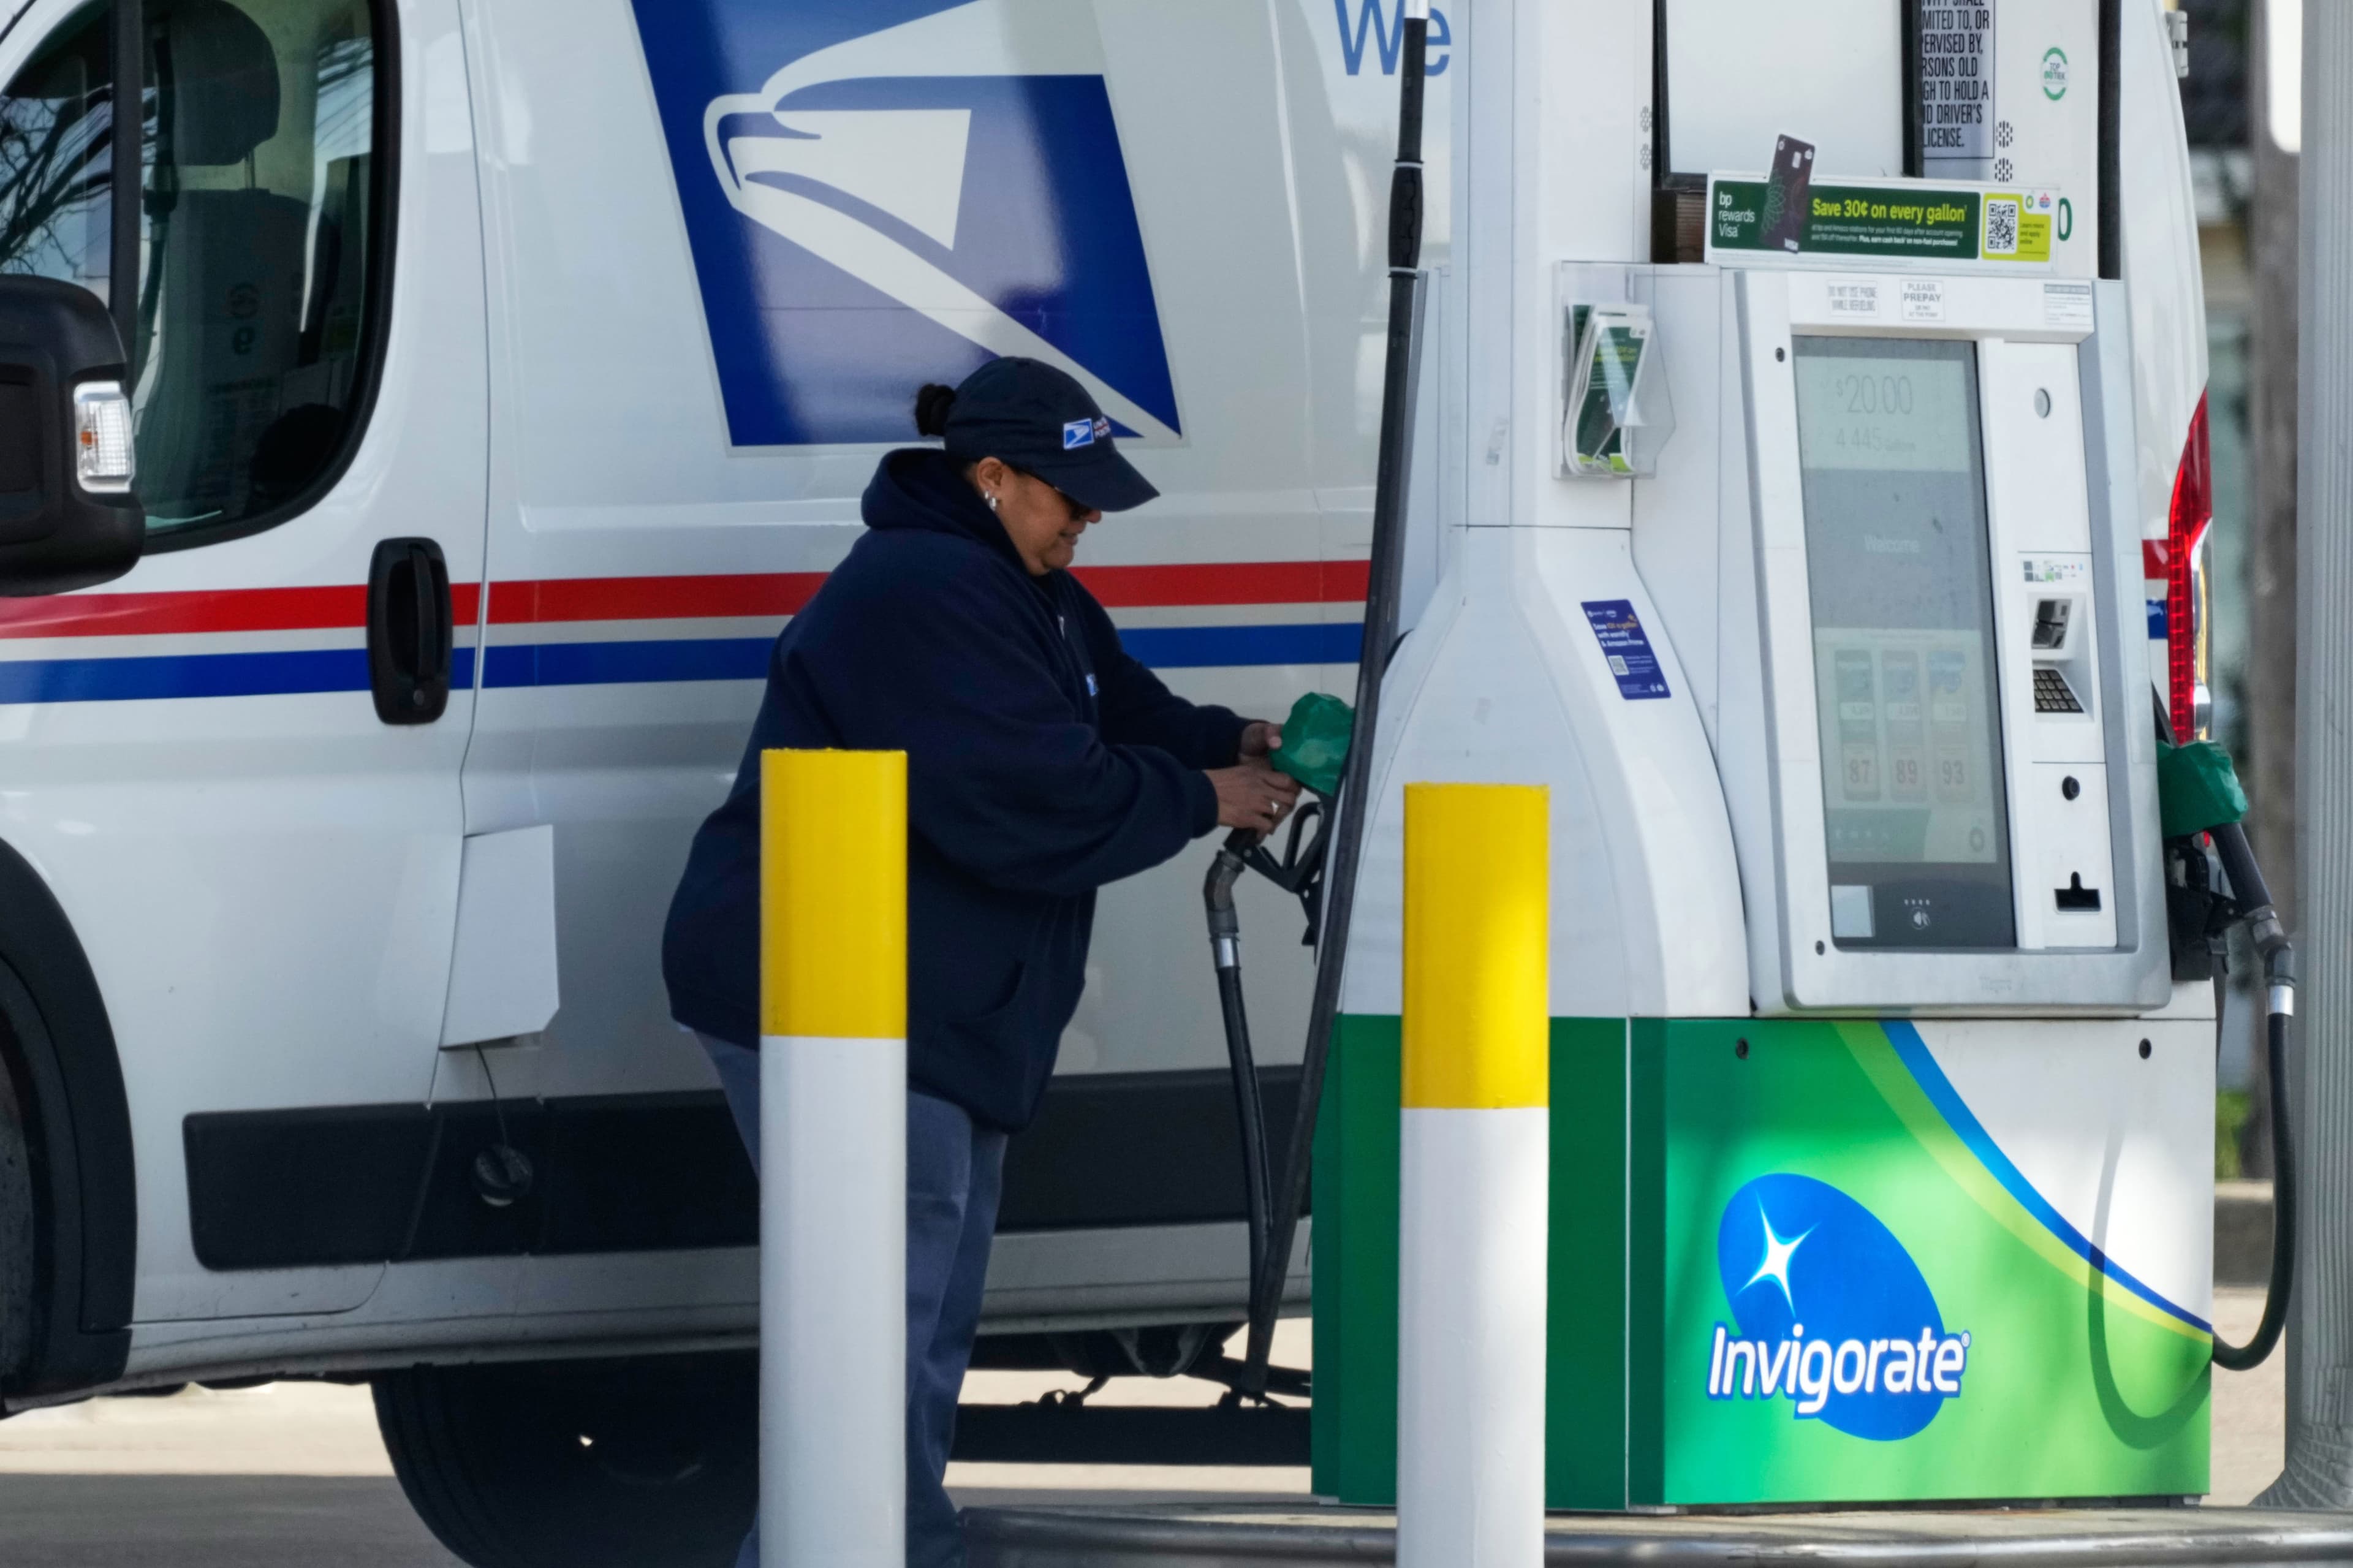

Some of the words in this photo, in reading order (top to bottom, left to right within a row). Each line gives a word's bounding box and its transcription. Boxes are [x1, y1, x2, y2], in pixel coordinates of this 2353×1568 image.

[1957, 10, 1972, 31] TO,
[1975, 10, 1989, 30] OR
[1334, 0, 1451, 76] We
[1922, 33, 1965, 54] ERVISED
[1969, 33, 1983, 55] BY,
[1958, 57, 1977, 77] OLD
[1939, 80, 1950, 100] TO
[1954, 80, 1979, 101] HOLD
[1982, 80, 1989, 100] A
[1937, 104, 1982, 124] DRIVER'S
[1719, 191, 1732, 208] bp
[1718, 209, 1756, 223] rewards
[1813, 198, 1841, 216] Save
[1844, 199, 1868, 218] 30¢
[1871, 203, 1887, 219] on
[1890, 205, 1924, 225] every
[1903, 292, 1941, 302] PREPAY
[1907, 283, 1936, 292] PLEASE
[1836, 374, 1913, 415] $20.00
[1848, 759, 1870, 784] 87
[1895, 759, 1919, 784] 89
[1942, 759, 1965, 786] 93
